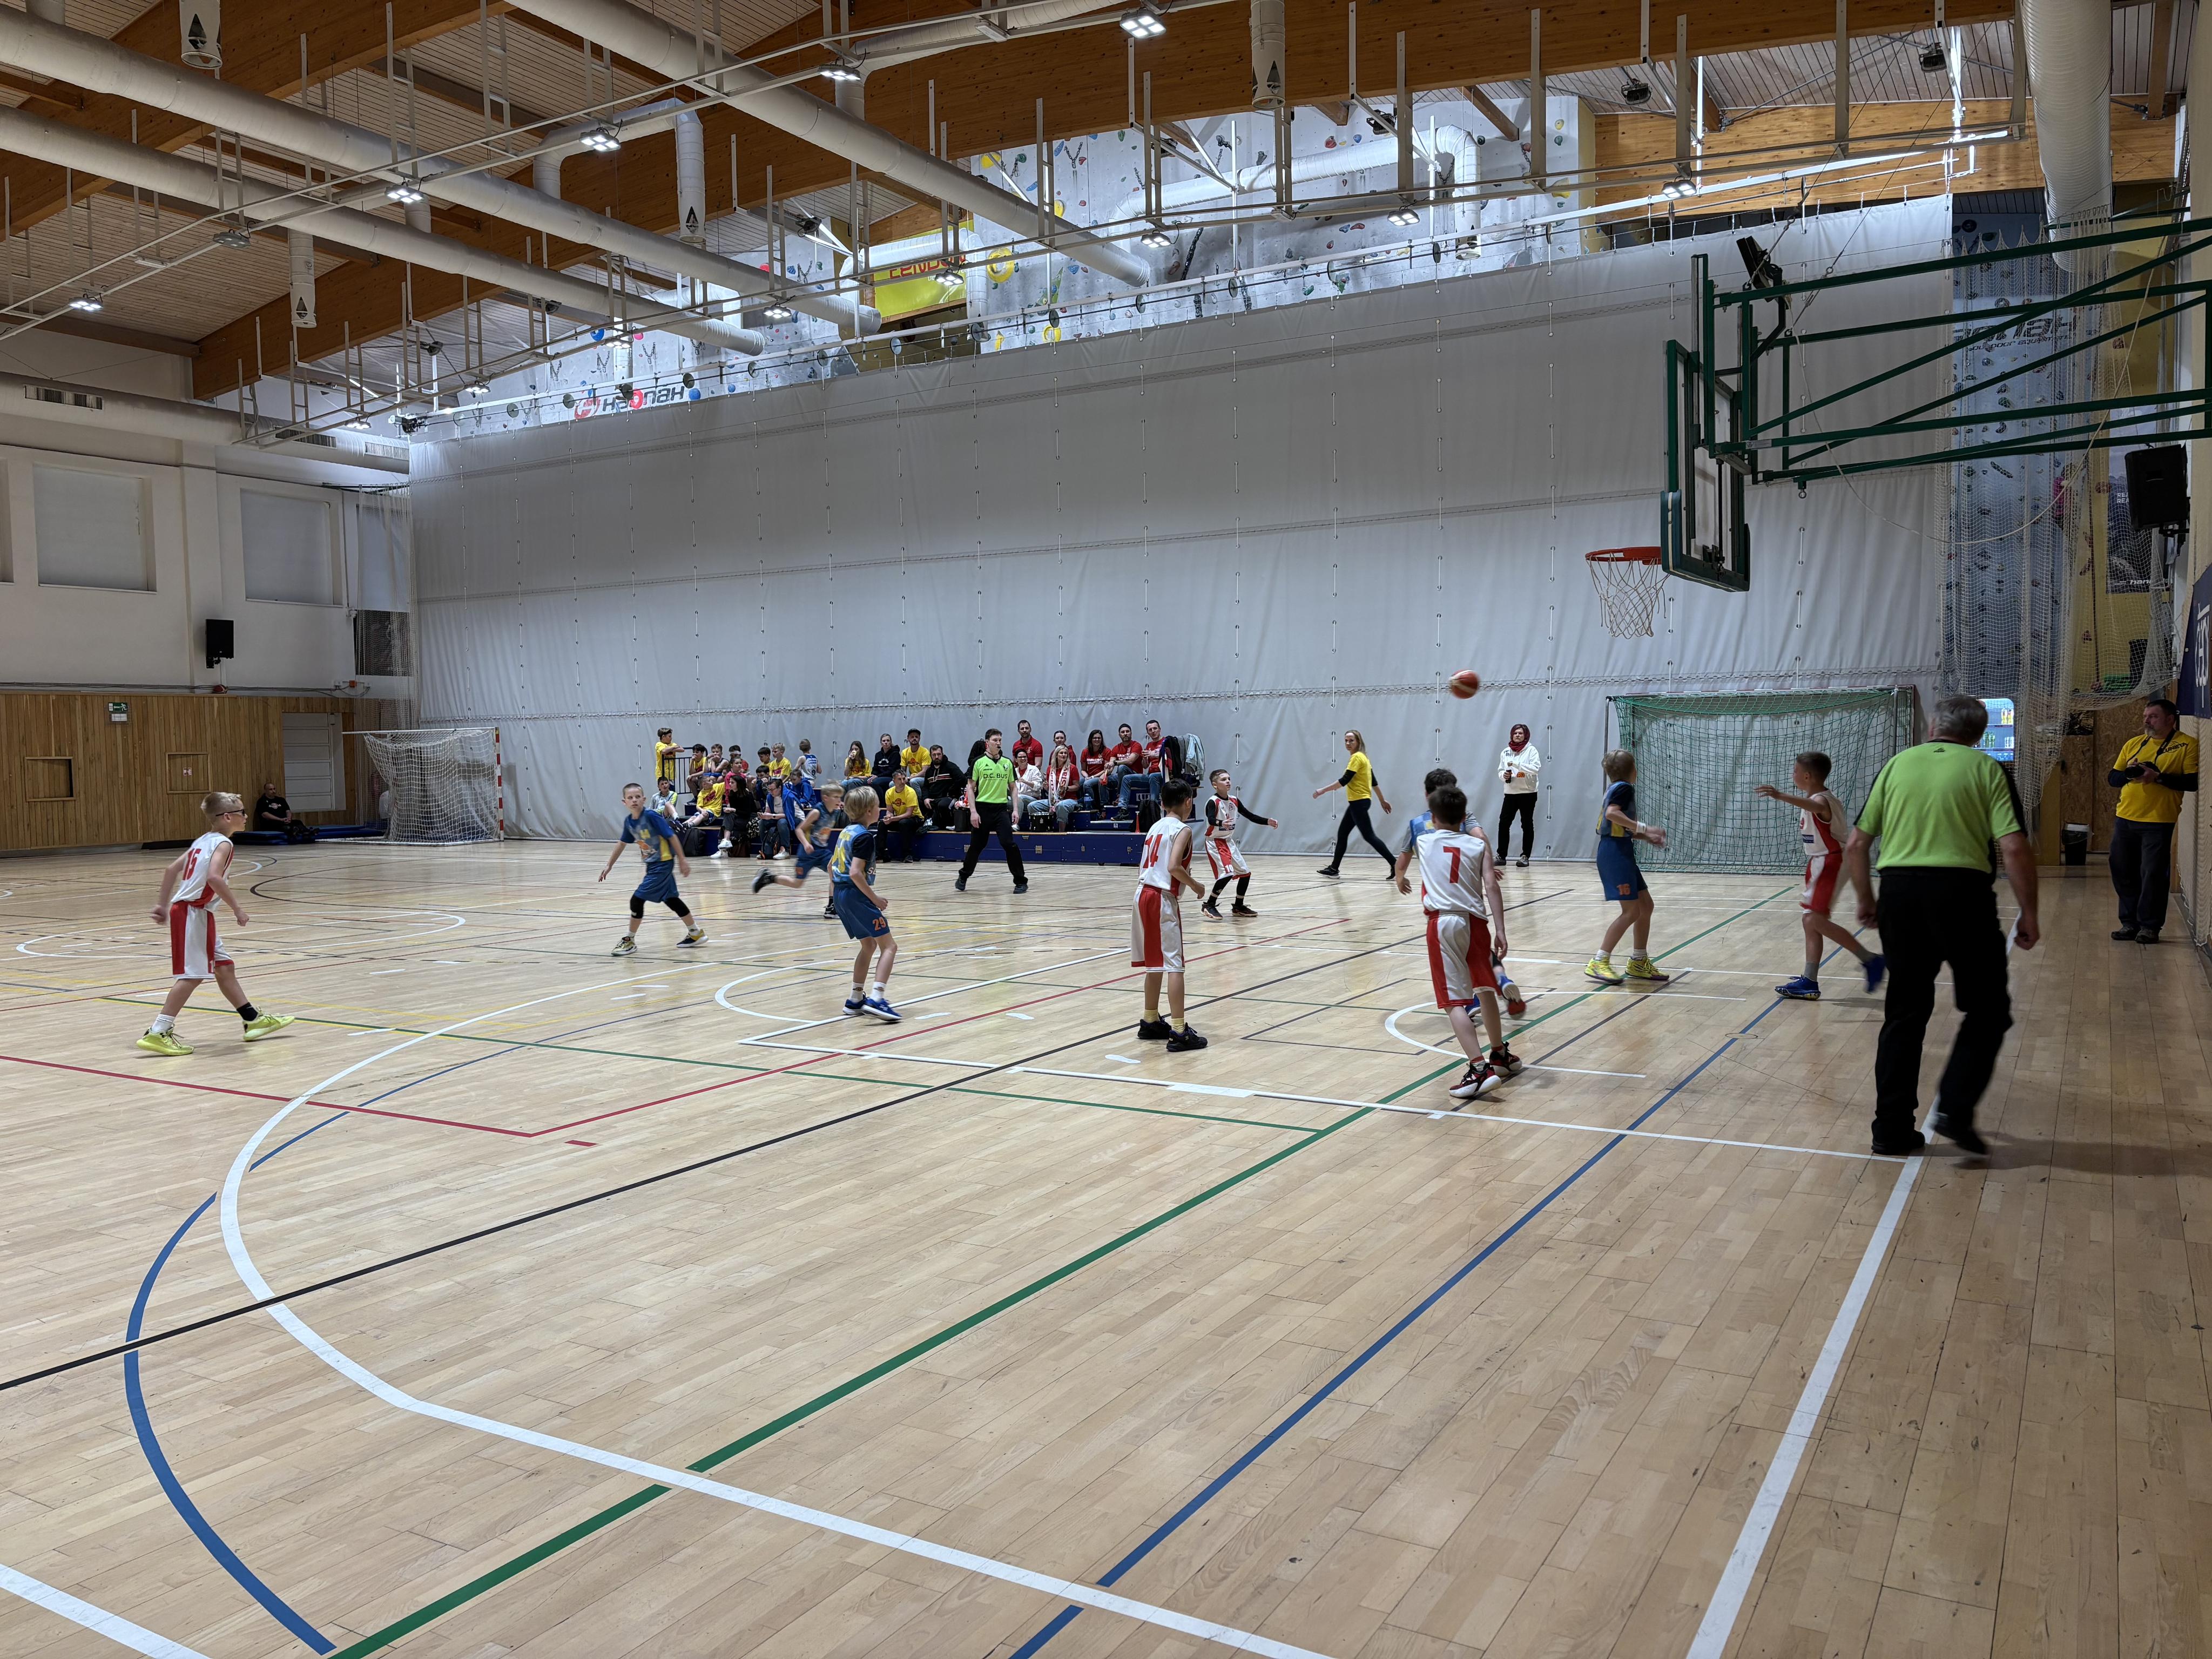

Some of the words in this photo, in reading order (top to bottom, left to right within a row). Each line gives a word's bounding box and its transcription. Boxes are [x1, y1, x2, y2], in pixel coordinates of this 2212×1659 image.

[182, 848, 201, 881] 15
[1142, 833, 1163, 869] 14
[1442, 846, 1461, 884] 7
[1616, 882, 1631, 896] 16
[872, 916, 886, 932] 29
